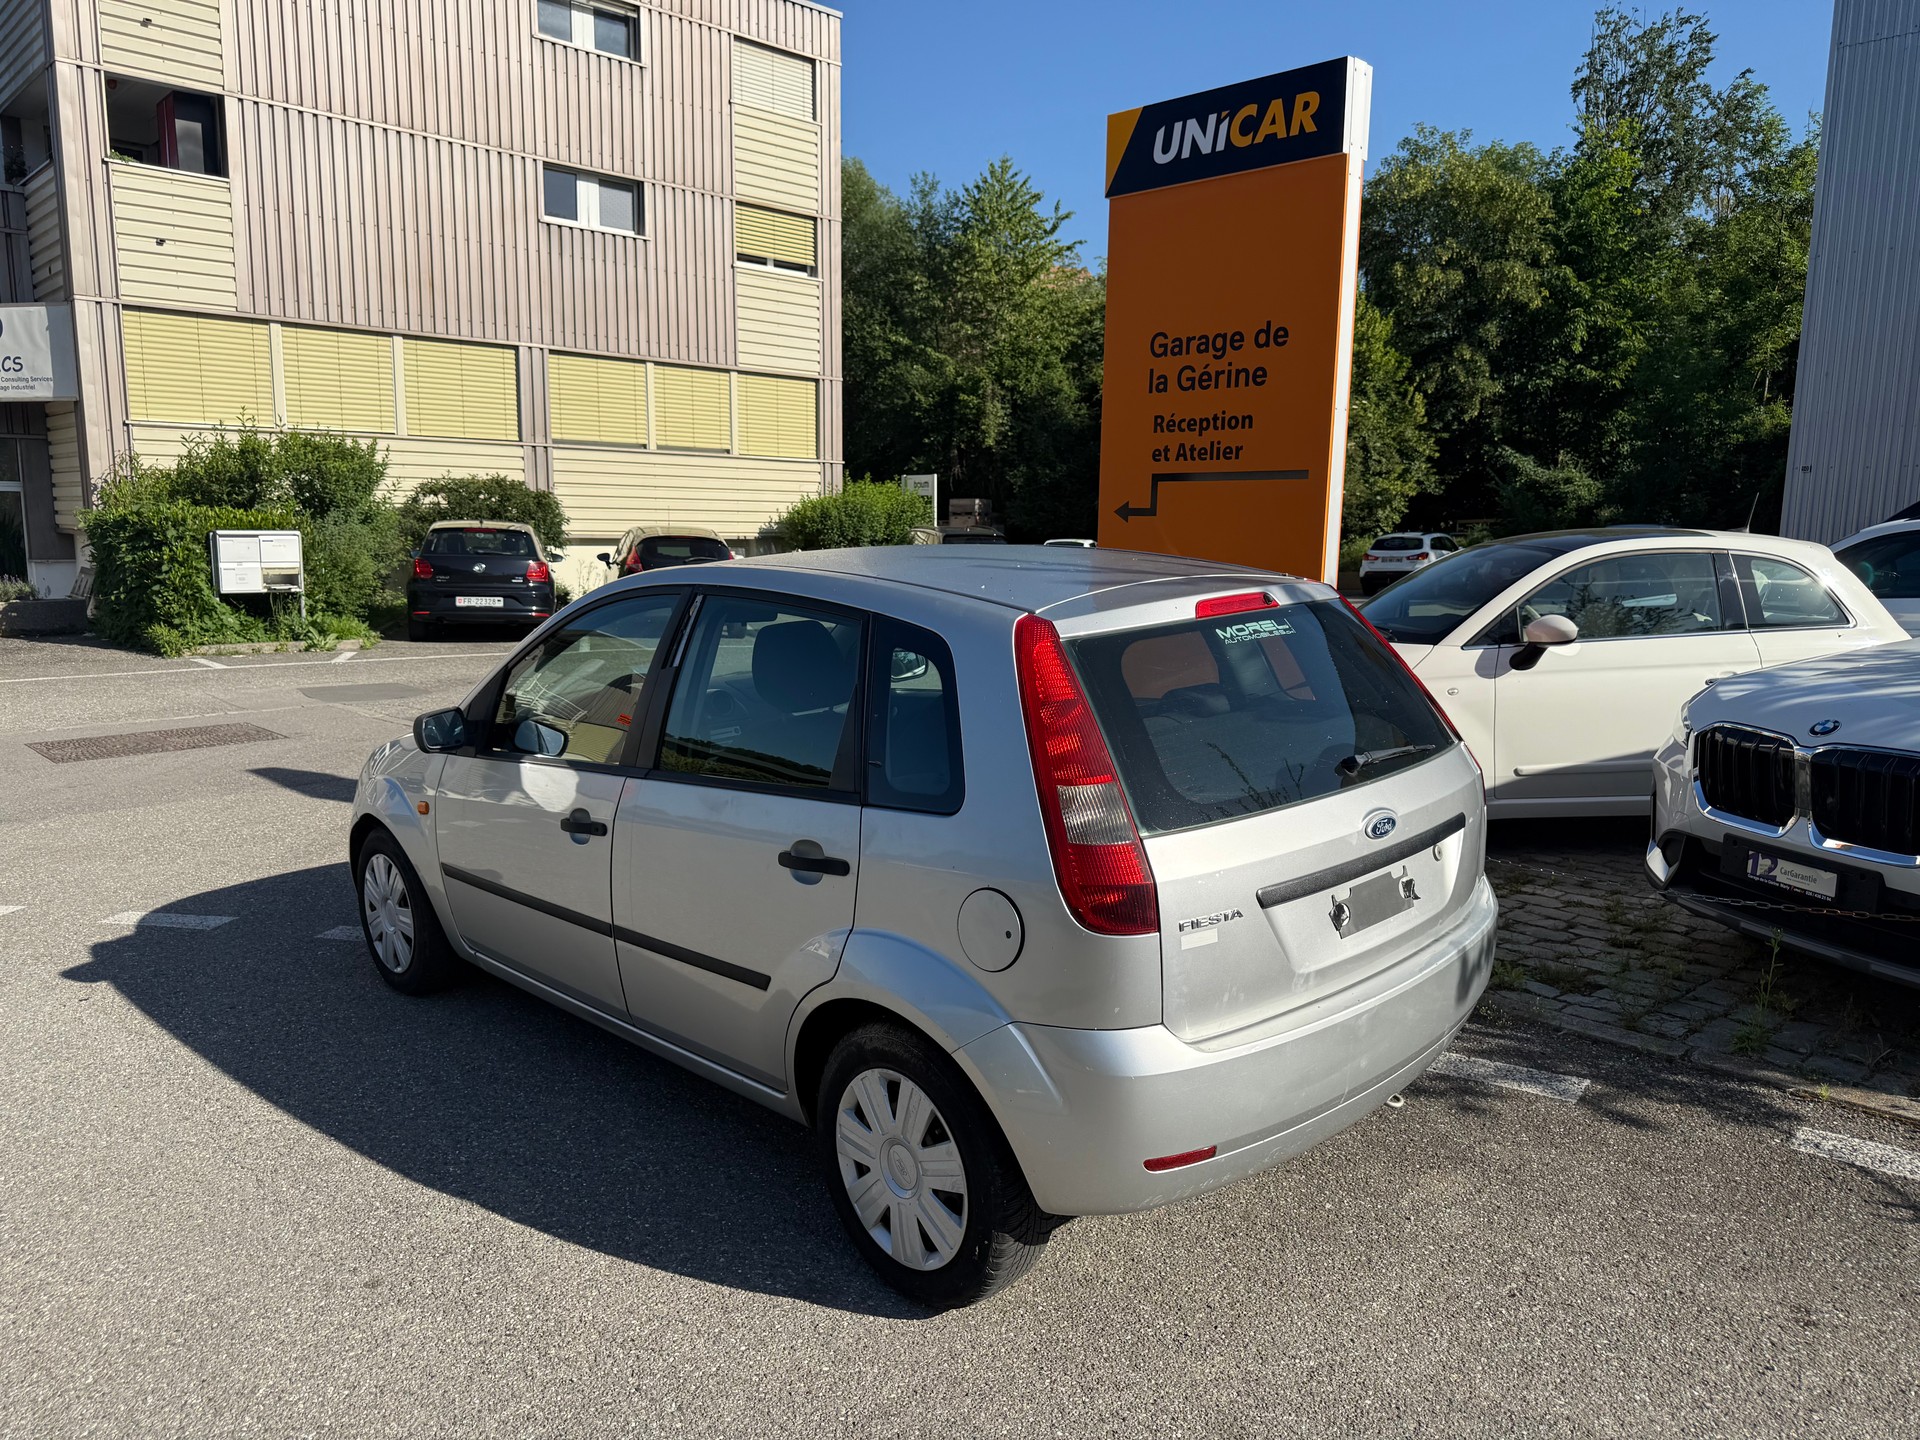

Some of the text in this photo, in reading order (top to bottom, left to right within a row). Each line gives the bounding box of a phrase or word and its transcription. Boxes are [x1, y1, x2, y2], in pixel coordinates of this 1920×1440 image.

[1150, 320, 1289, 360] Garage de
[0, 356, 23, 372] CS
[1148, 362, 1268, 394] la Gérine
[1153, 410, 1254, 436] Réception
[1152, 440, 1243, 462] et Atelier
[1215, 619, 1289, 639] MOREL
[1375, 818, 1393, 835] Ford
[1779, 867, 1818, 884] CarGarantie
[1178, 908, 1244, 932] FIESTA
